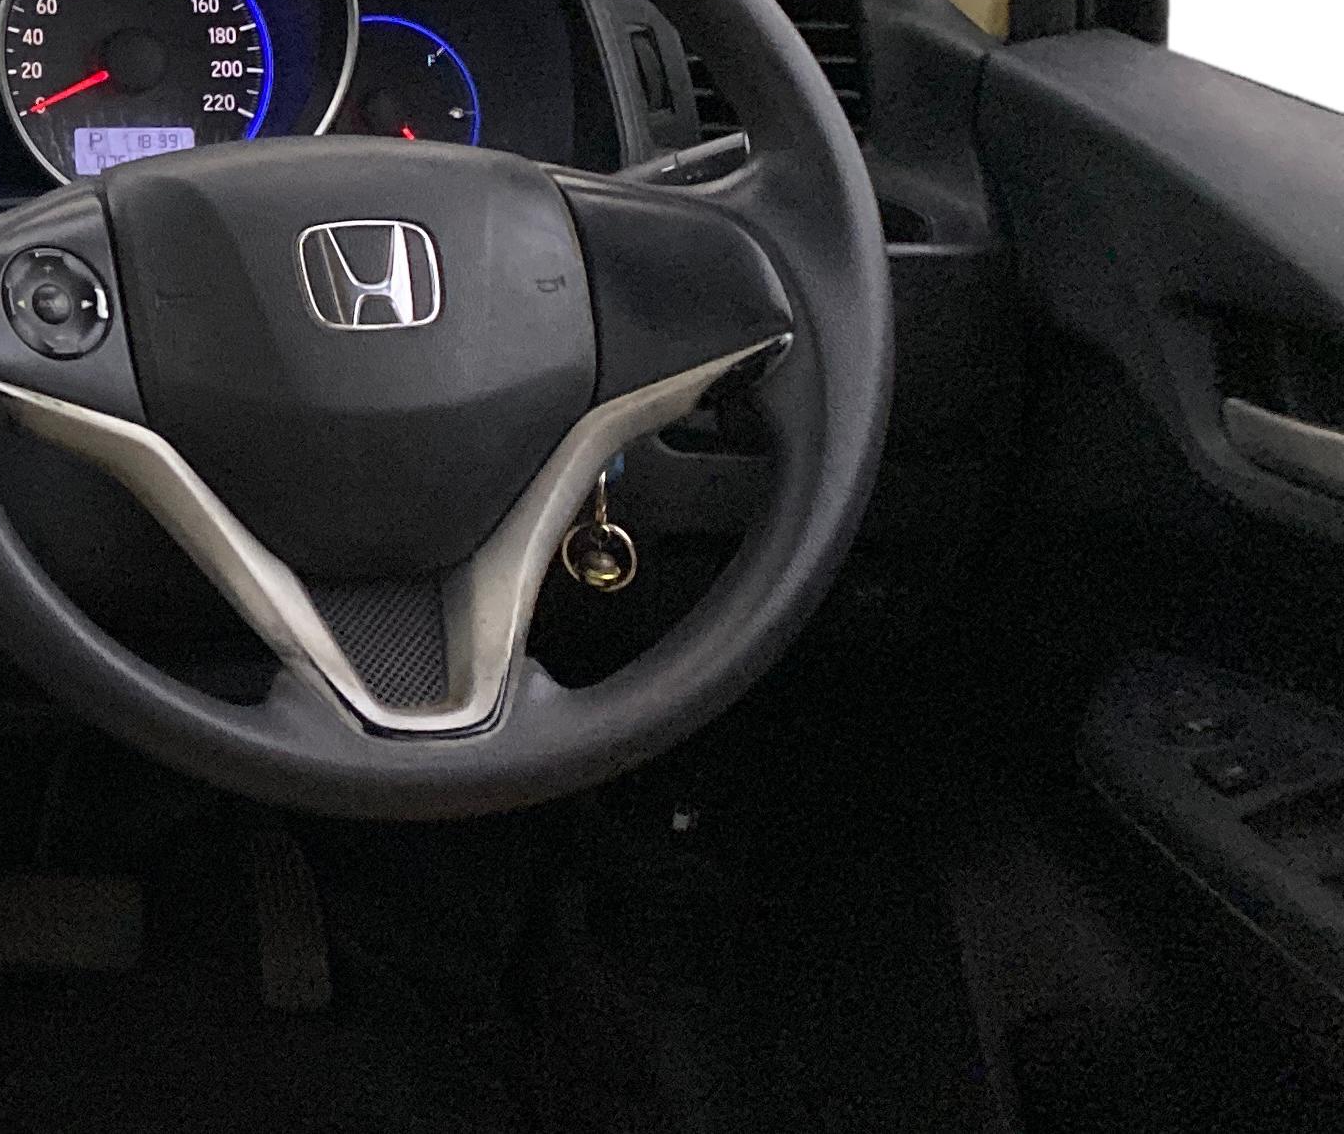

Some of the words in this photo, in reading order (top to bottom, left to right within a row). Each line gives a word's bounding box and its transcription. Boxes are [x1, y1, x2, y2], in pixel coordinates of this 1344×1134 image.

[22, 28, 44, 46] 40
[207, 26, 237, 44] 180
[210, 60, 243, 78] 200
[427, 54, 436, 67] F
[21, 61, 43, 79] 20
[202, 93, 236, 111] 220
[89, 132, 103, 150] P
